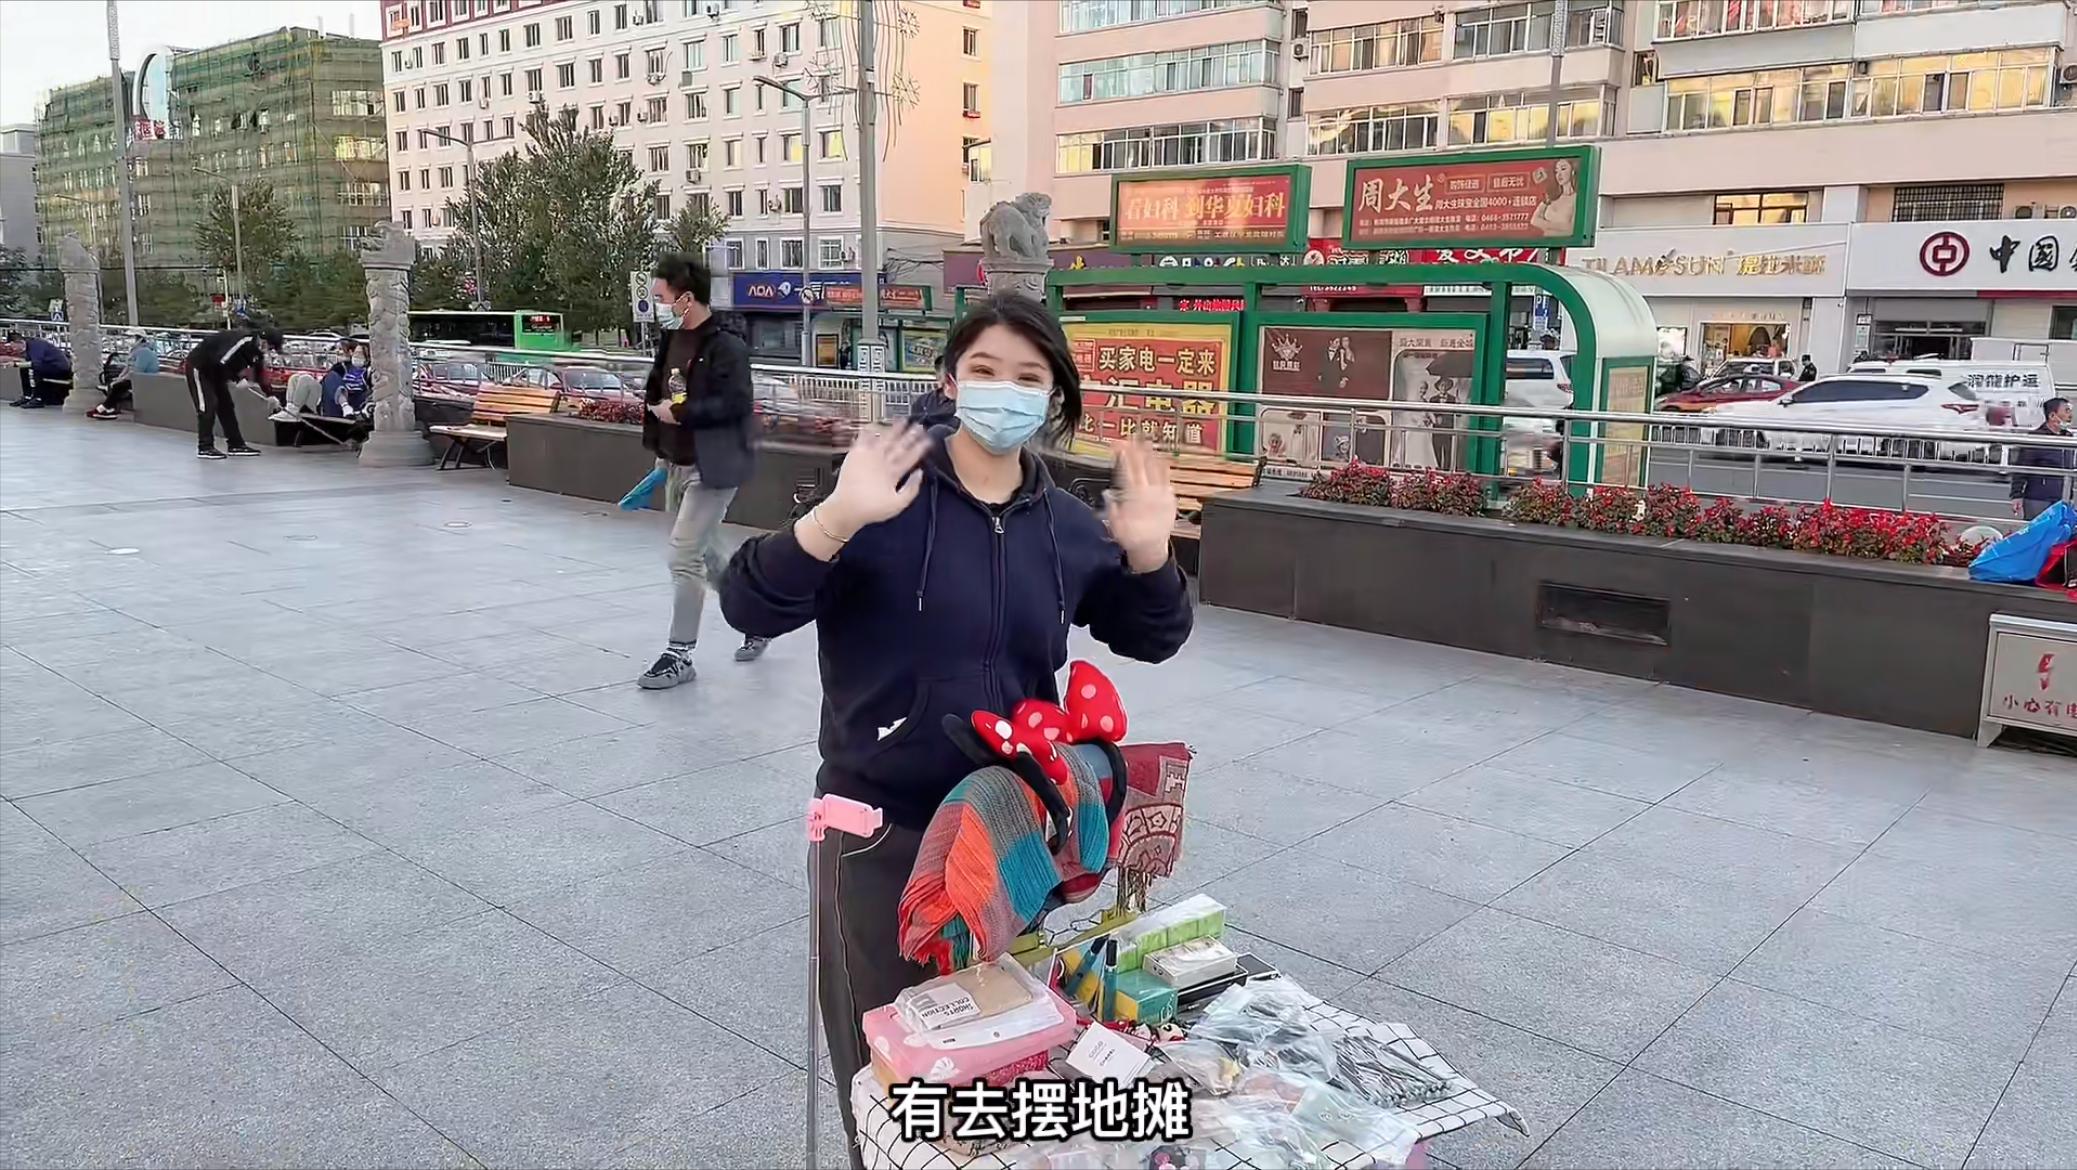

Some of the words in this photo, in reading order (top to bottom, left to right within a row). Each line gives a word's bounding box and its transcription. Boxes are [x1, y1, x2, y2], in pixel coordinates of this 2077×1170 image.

[1358, 174, 1433, 213] 周大生
[1989, 234, 2077, 275] 中國
[1099, 345, 1216, 376] 买家电一定来
[1080, 374, 1216, 416] 汇电器
